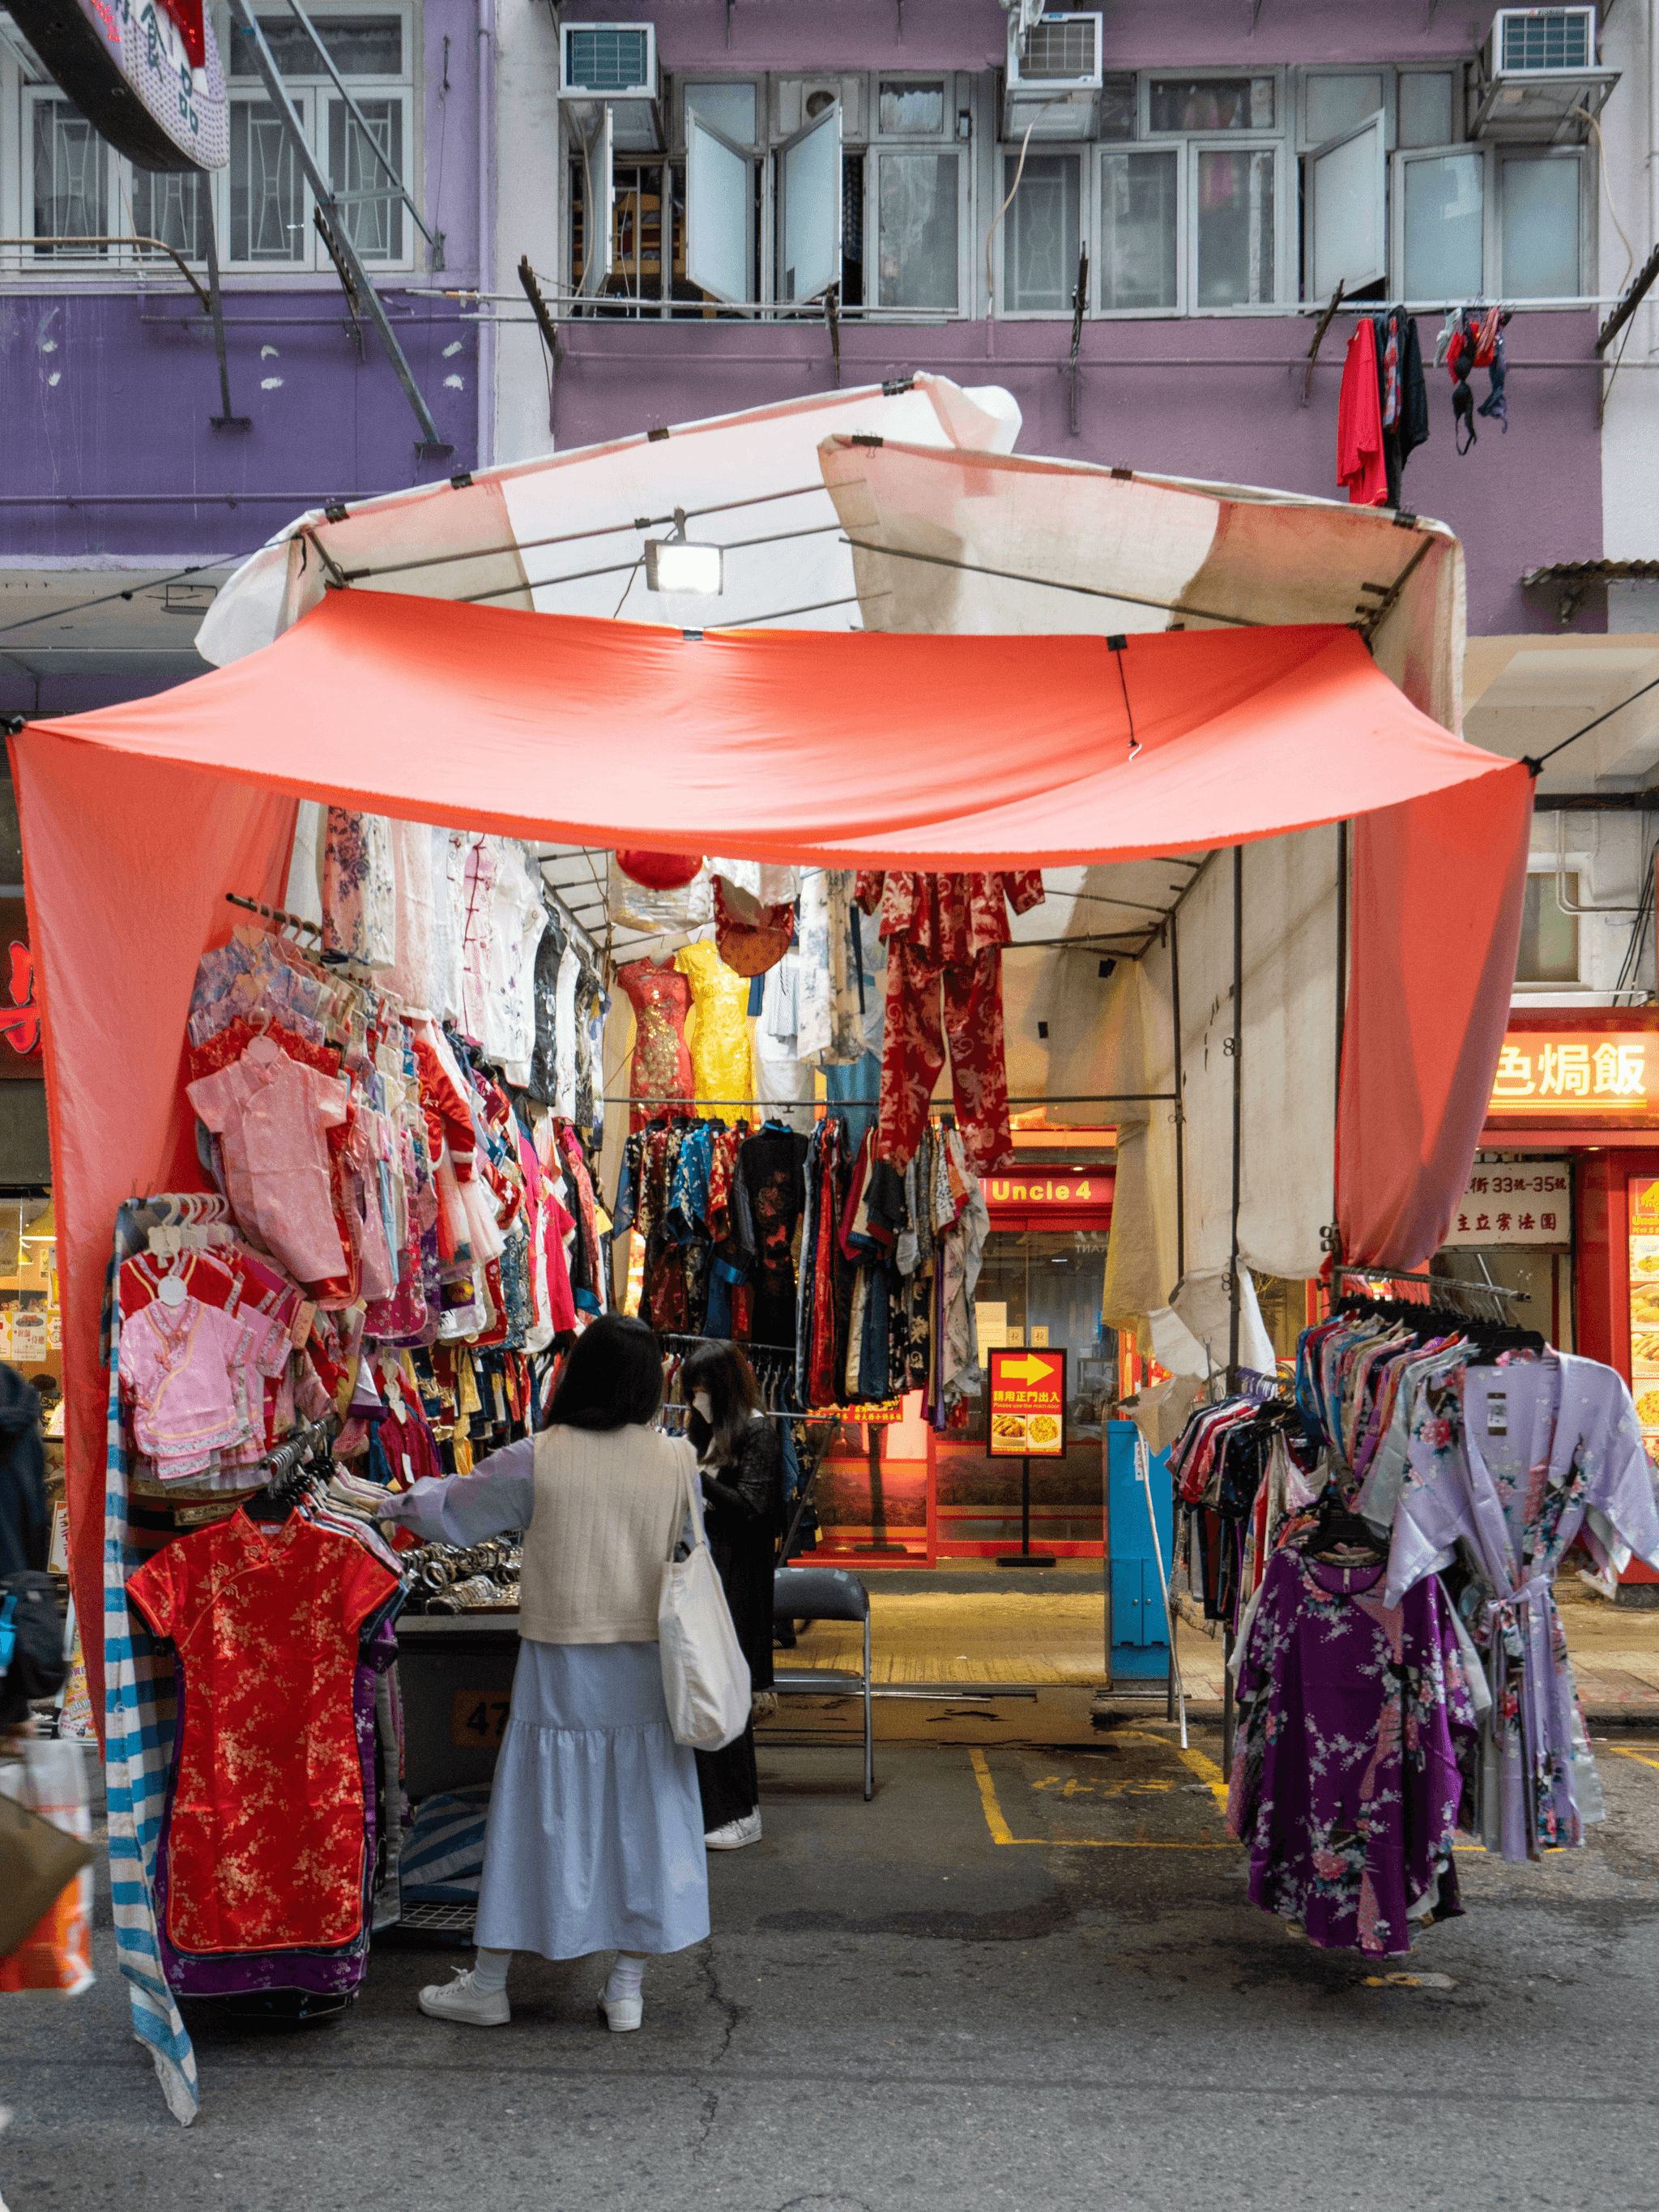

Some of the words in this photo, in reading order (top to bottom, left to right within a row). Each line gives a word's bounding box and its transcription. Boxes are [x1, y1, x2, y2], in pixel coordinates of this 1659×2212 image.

[1492, 1043, 1648, 1096] 色焗飯
[992, 1181, 1070, 1201] Uncle
[1076, 1181, 1091, 1200] 4
[993, 1390, 1060, 1403] 請用正門出入
